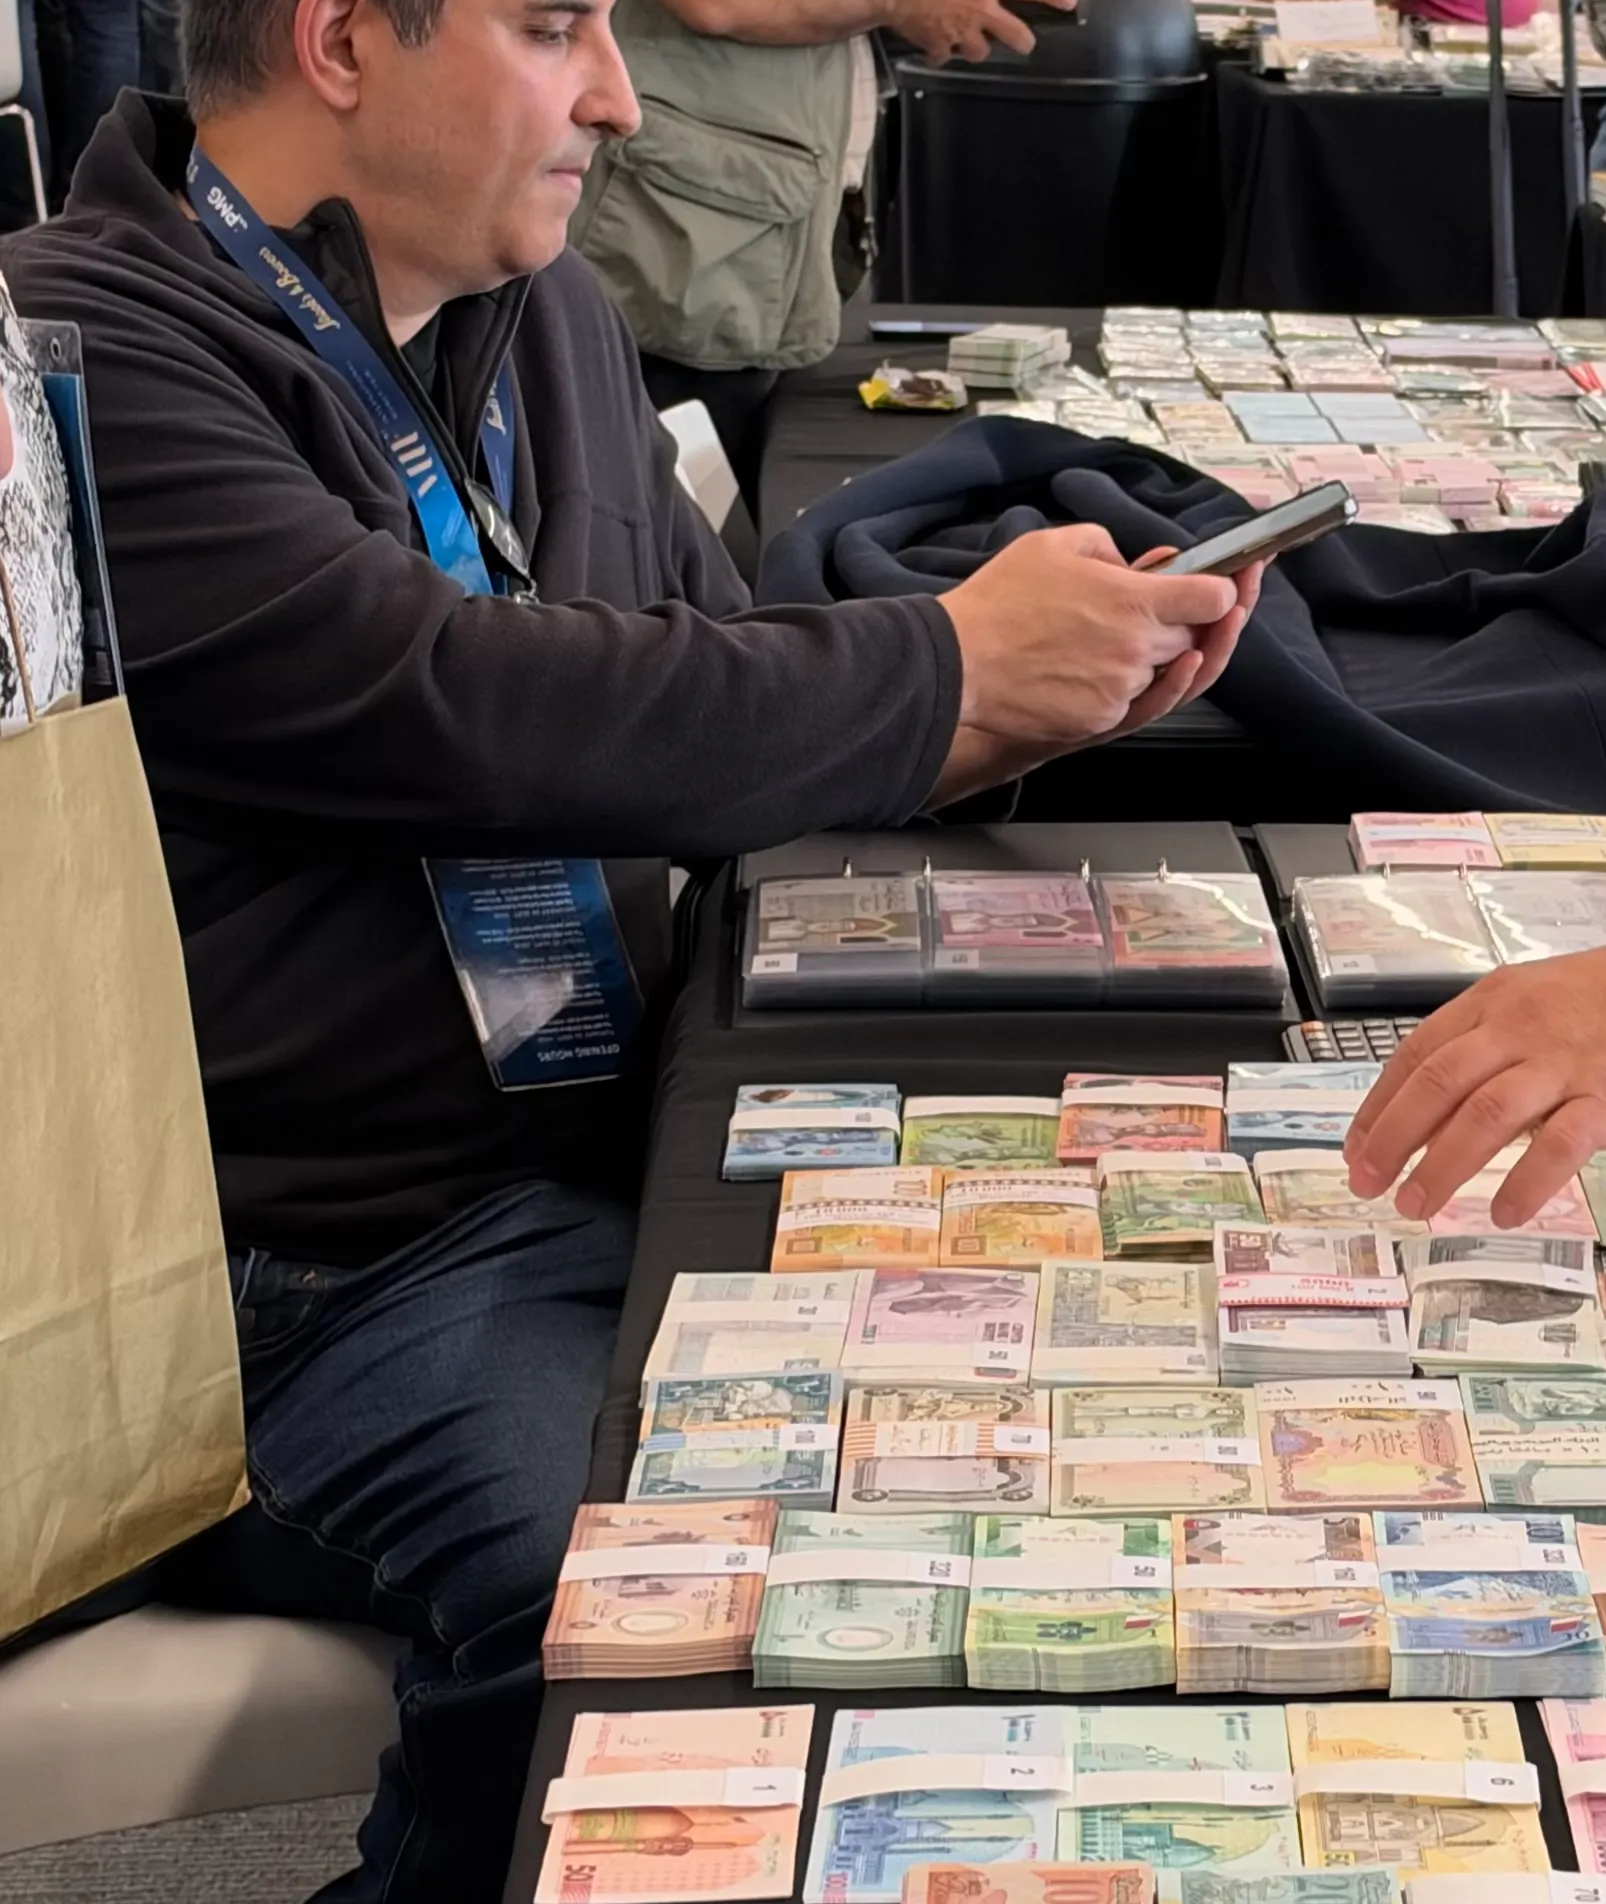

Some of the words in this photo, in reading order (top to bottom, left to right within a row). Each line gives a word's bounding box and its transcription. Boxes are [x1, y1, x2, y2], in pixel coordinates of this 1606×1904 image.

[206, 186, 246, 229] PMG
[563, 1864, 597, 1881] 50
[1575, 1889, 1600, 1902] 70
